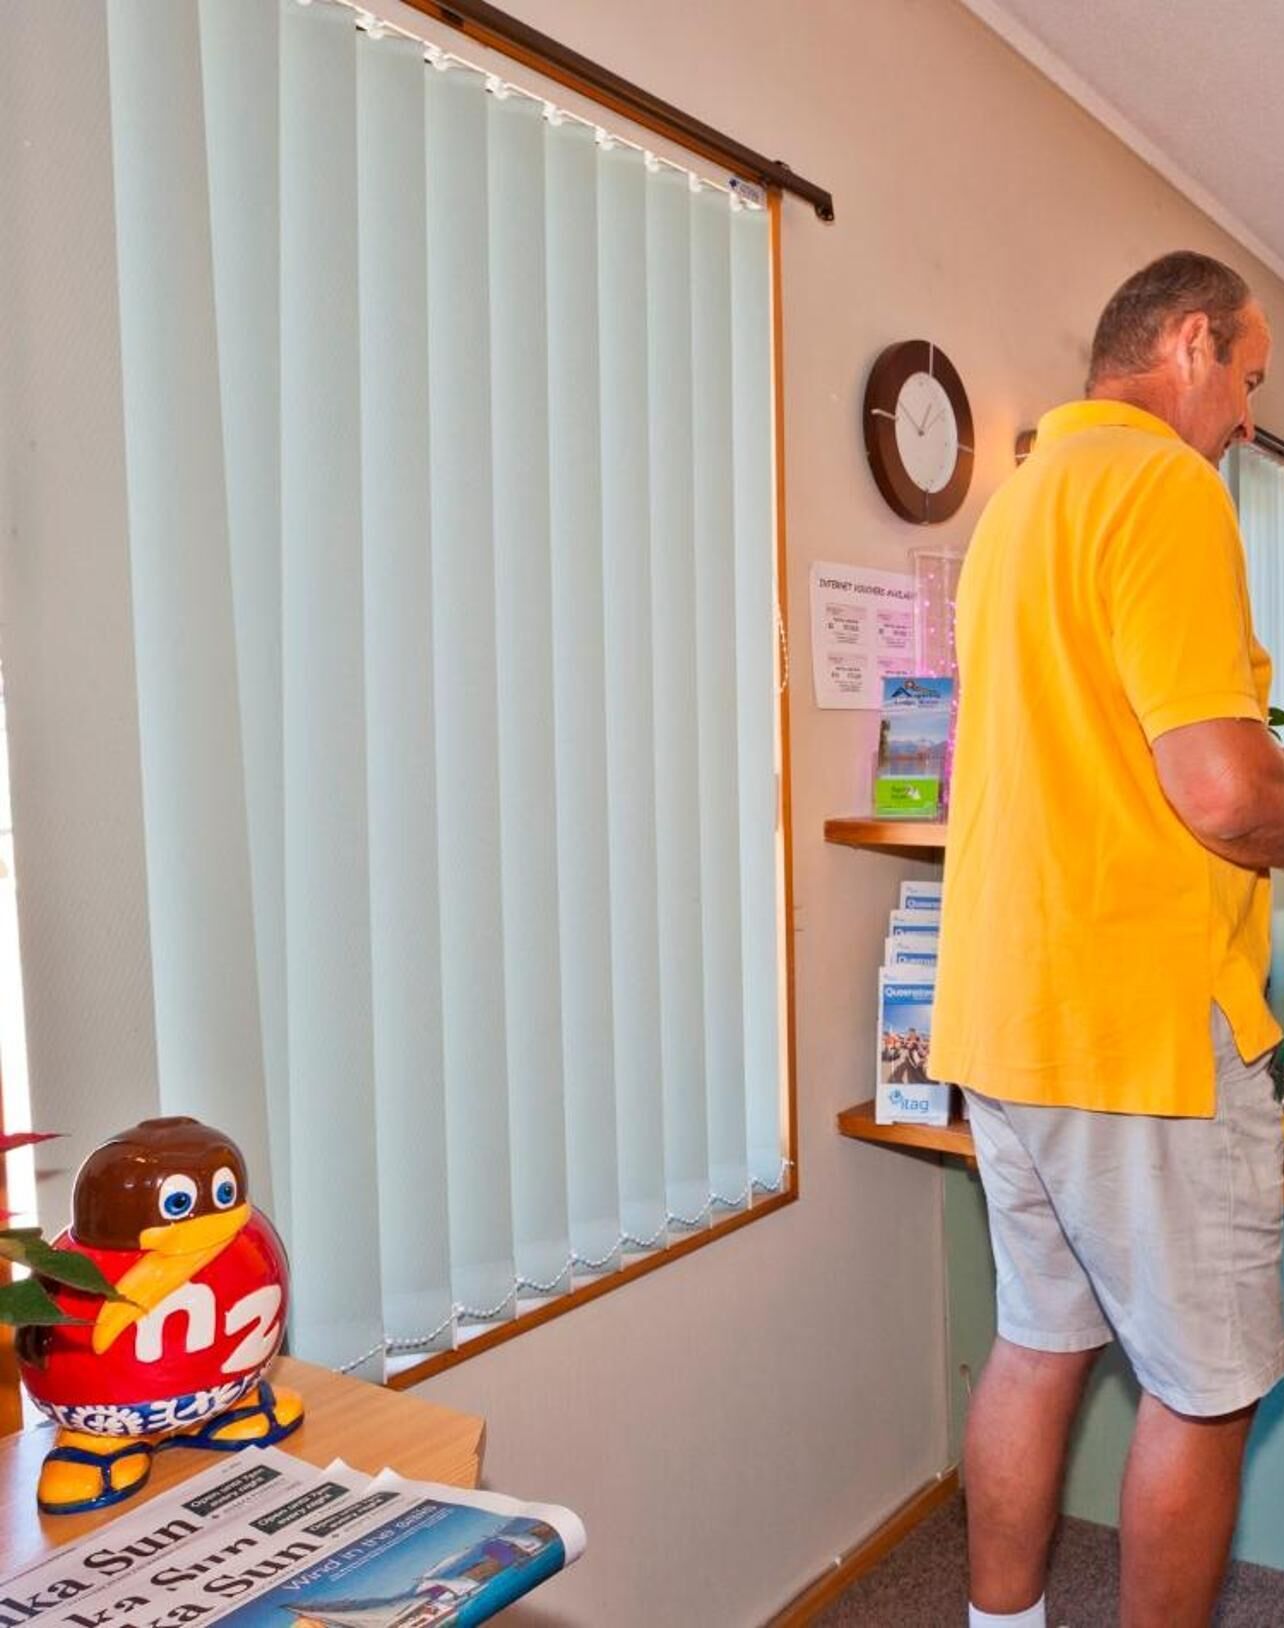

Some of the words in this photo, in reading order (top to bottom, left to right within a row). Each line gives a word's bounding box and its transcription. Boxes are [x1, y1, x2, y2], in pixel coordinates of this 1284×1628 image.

[83, 1519, 204, 1577] Sun
[203, 1541, 326, 1598] Sun
[281, 1557, 343, 1591] Wind
[340, 1547, 364, 1562] in
[362, 1528, 395, 1548] the
